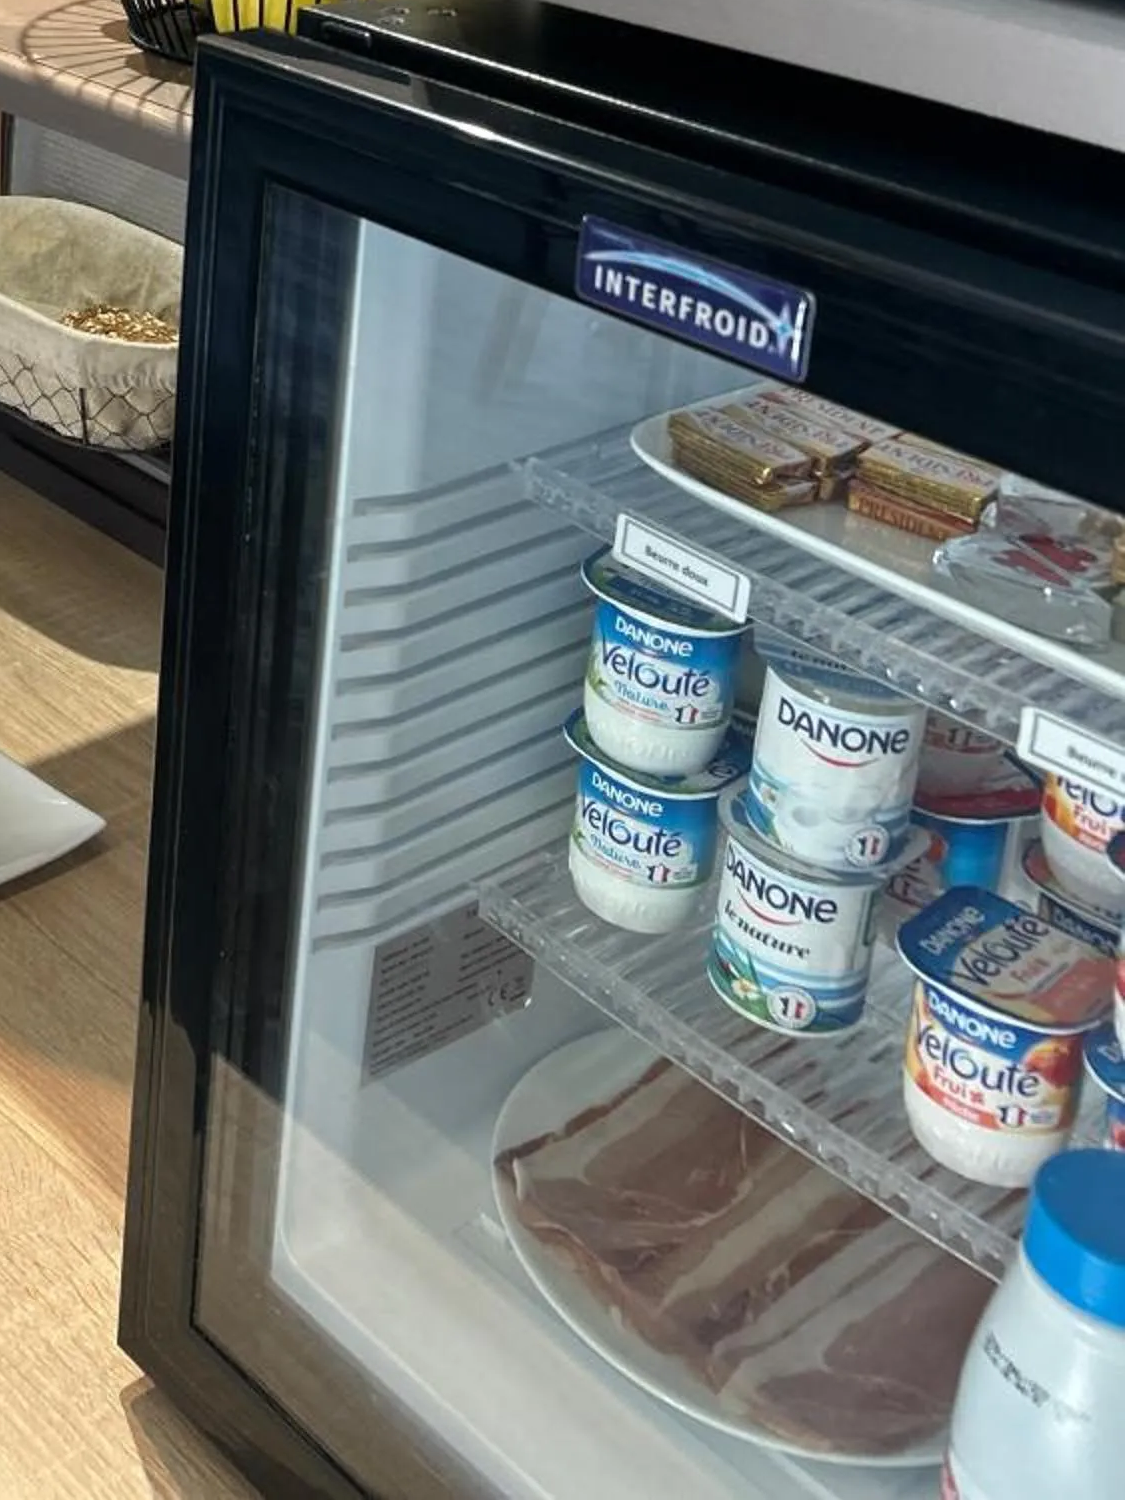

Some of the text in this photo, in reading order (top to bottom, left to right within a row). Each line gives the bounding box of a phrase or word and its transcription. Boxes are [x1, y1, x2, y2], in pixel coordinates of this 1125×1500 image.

[593, 264, 771, 350] INTERFROID
[643, 544, 709, 588] Beurre doux
[614, 615, 694, 658] DANONE
[777, 696, 911, 755] DANONE
[592, 771, 665, 818] DANONE
[725, 842, 839, 924] DANONE
[927, 989, 1018, 1050] DANONE
